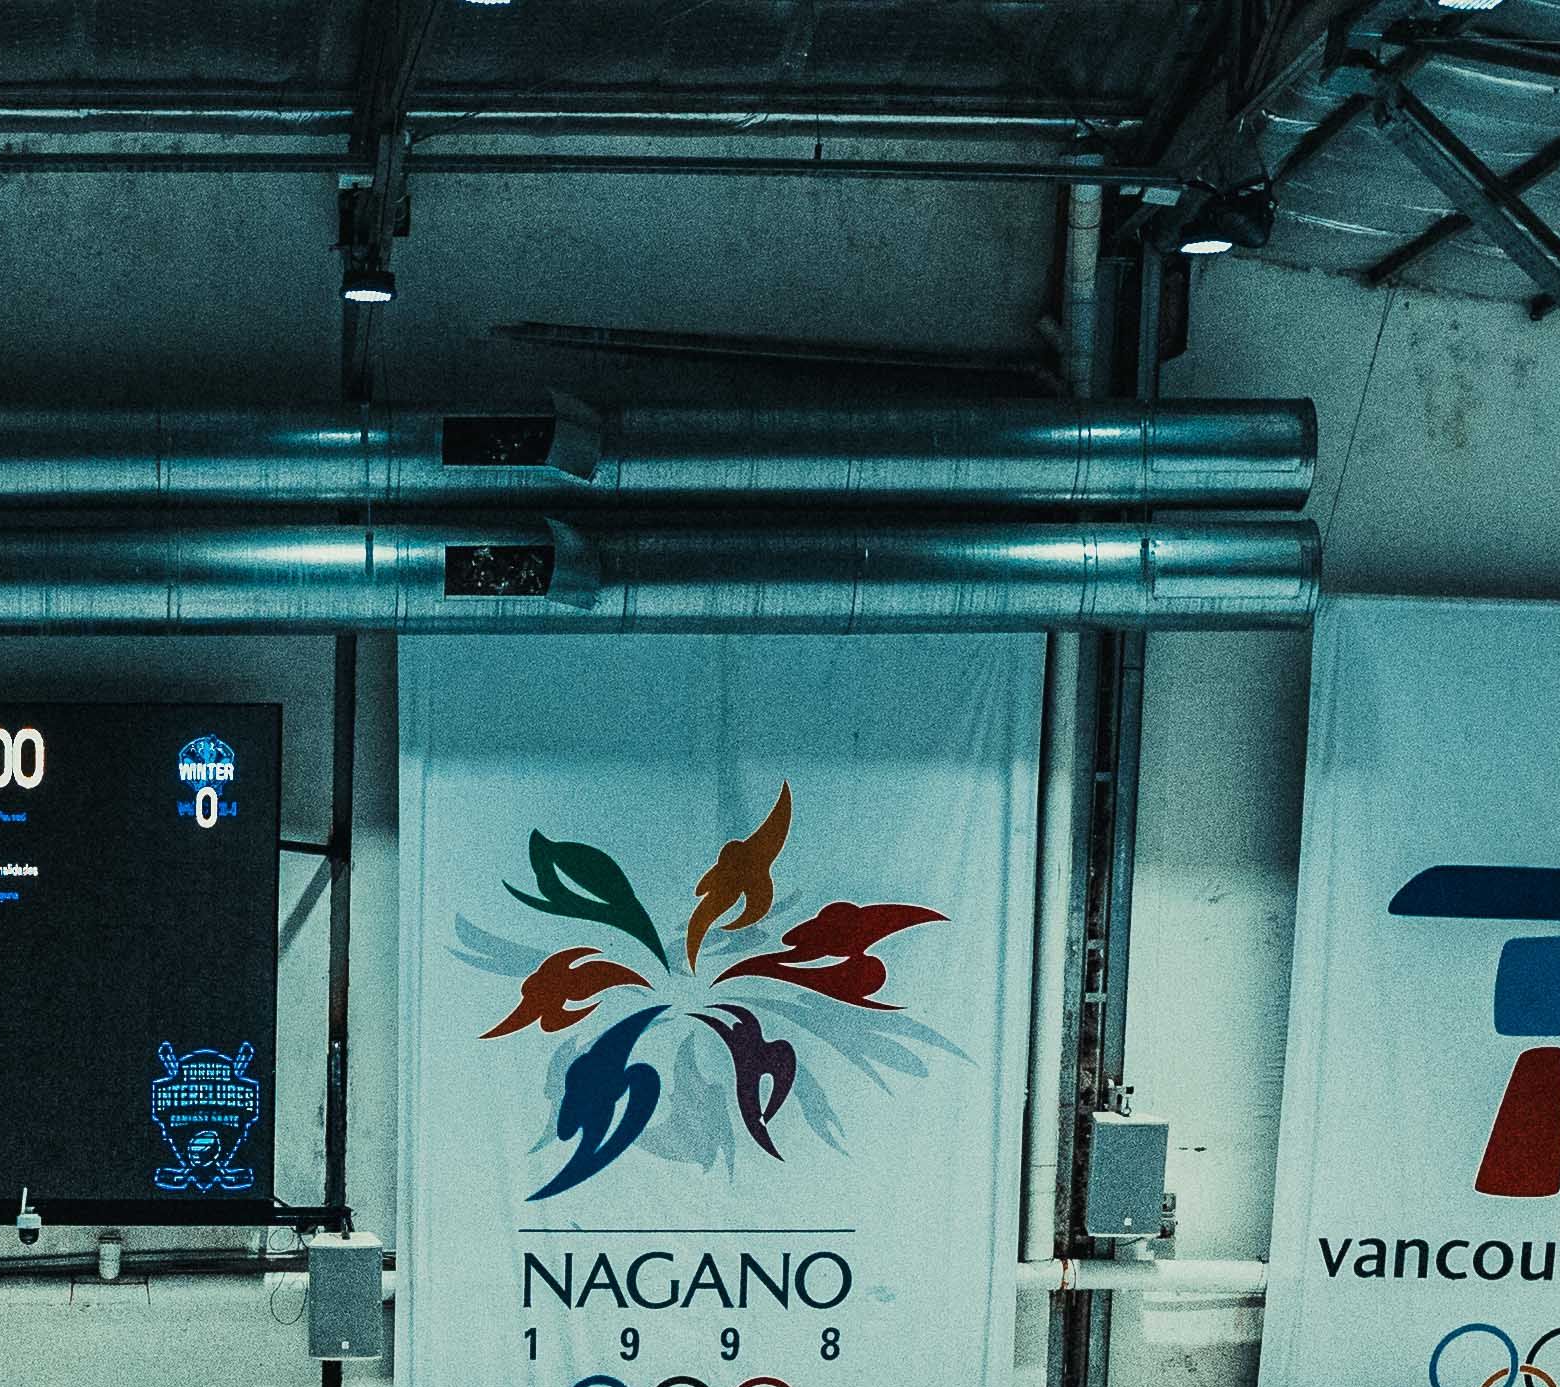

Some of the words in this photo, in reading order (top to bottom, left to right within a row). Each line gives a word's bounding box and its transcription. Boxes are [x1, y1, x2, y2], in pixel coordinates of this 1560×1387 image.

[179, 762, 234, 780] WINTER
[196, 787, 218, 828] 0
[522, 1251, 852, 1310] NAGANO
